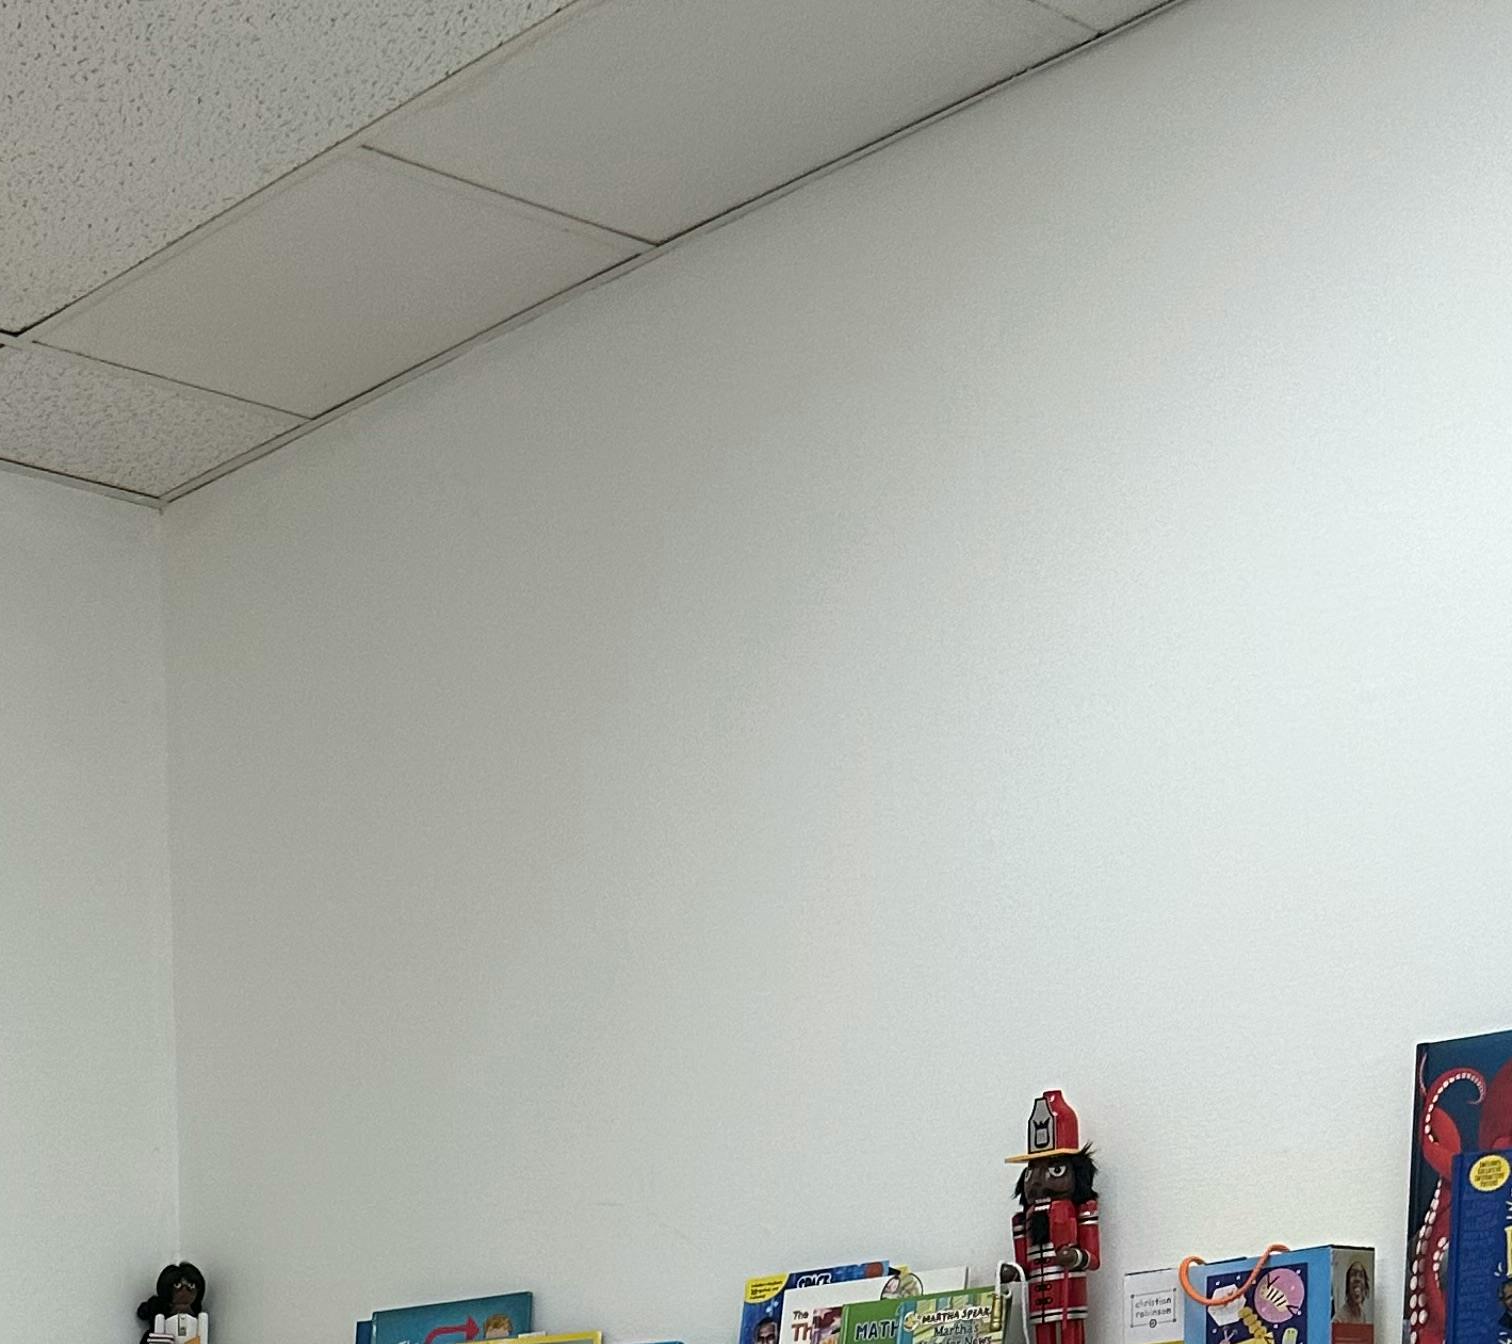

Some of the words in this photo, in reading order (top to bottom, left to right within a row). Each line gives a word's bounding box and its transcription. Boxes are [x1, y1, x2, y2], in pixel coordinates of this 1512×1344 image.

[792, 1310, 809, 1320] The
[922, 1311, 961, 1324] MARTHA
[934, 1323, 979, 1338] Martha's
